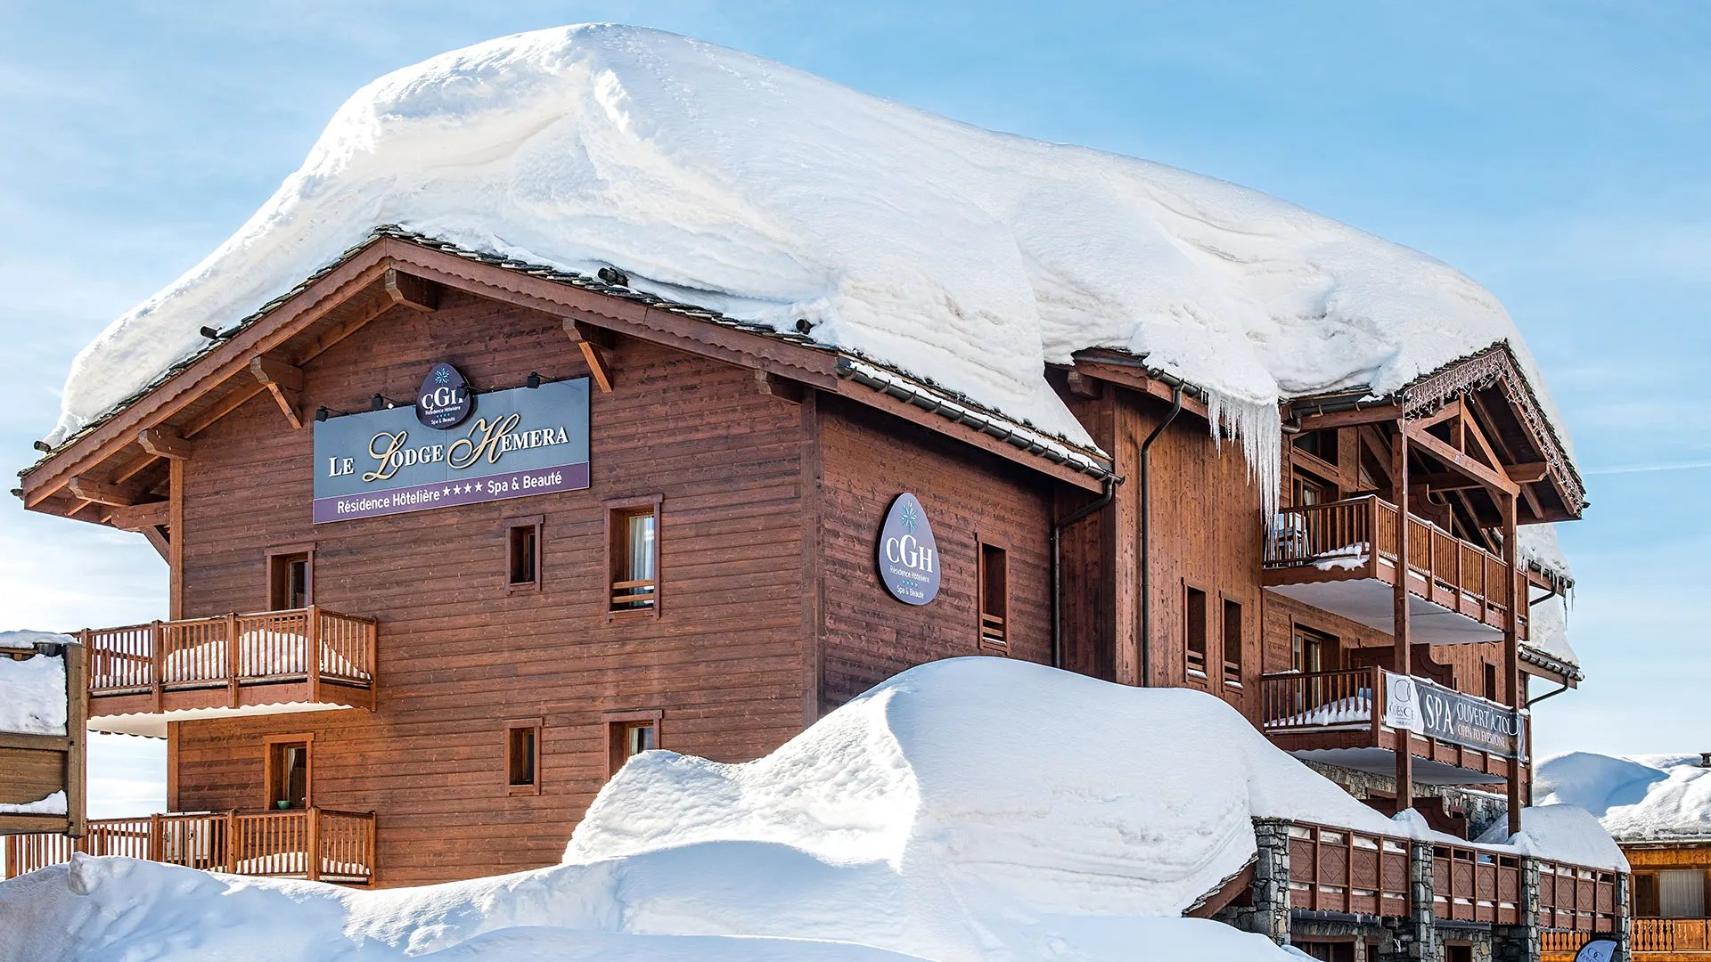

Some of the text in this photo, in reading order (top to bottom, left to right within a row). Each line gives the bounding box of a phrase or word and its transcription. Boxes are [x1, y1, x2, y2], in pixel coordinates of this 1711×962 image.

[328, 457, 355, 477] LE
[337, 471, 562, 514] Résidence Hôtelière Spa & Beauté
[886, 534, 933, 573] CGH
[1426, 694, 1454, 735] SPA
[1457, 702, 1489, 728] OUVERT
